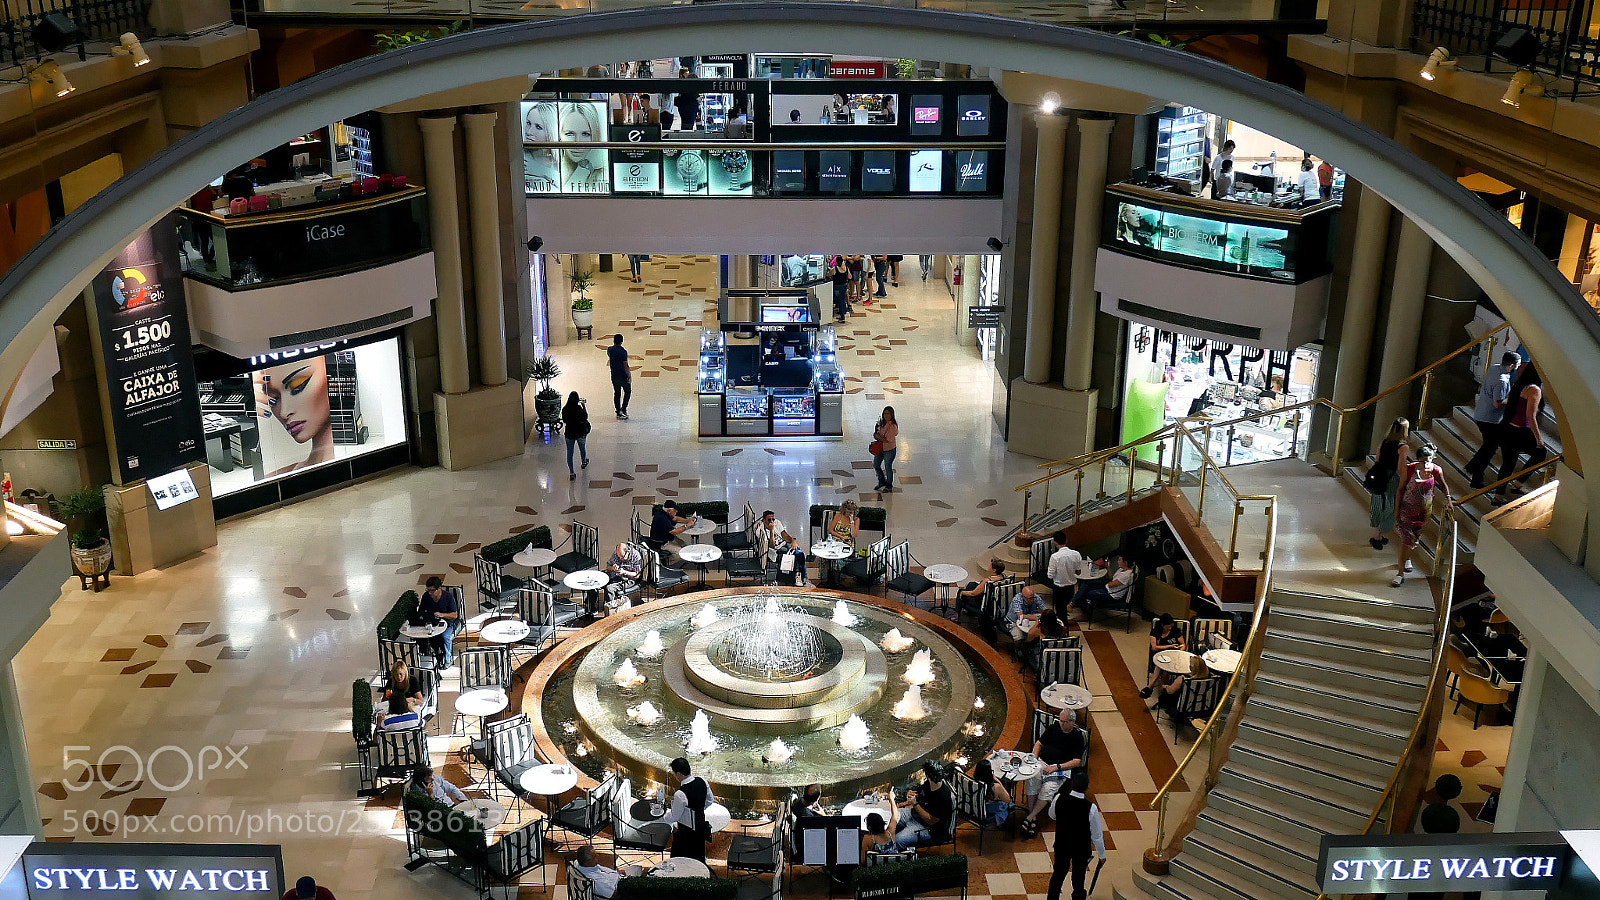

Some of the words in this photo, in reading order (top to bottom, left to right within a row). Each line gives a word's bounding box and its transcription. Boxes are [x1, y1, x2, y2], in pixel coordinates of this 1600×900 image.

[713, 81, 747, 91] FERAUD
[305, 224, 345, 243] iCase
[1168, 227, 1218, 247] BIOERM
[122, 320, 171, 349] 1.500
[123, 372, 165, 392] CAIXA
[167, 369, 178, 381] DE
[125, 380, 180, 406] ALFAJOR
[33, 868, 139, 890] STYLE
[145, 869, 270, 892] WATCH
[1331, 858, 1432, 881] STYLE
[1440, 856, 1557, 879] WATCH
